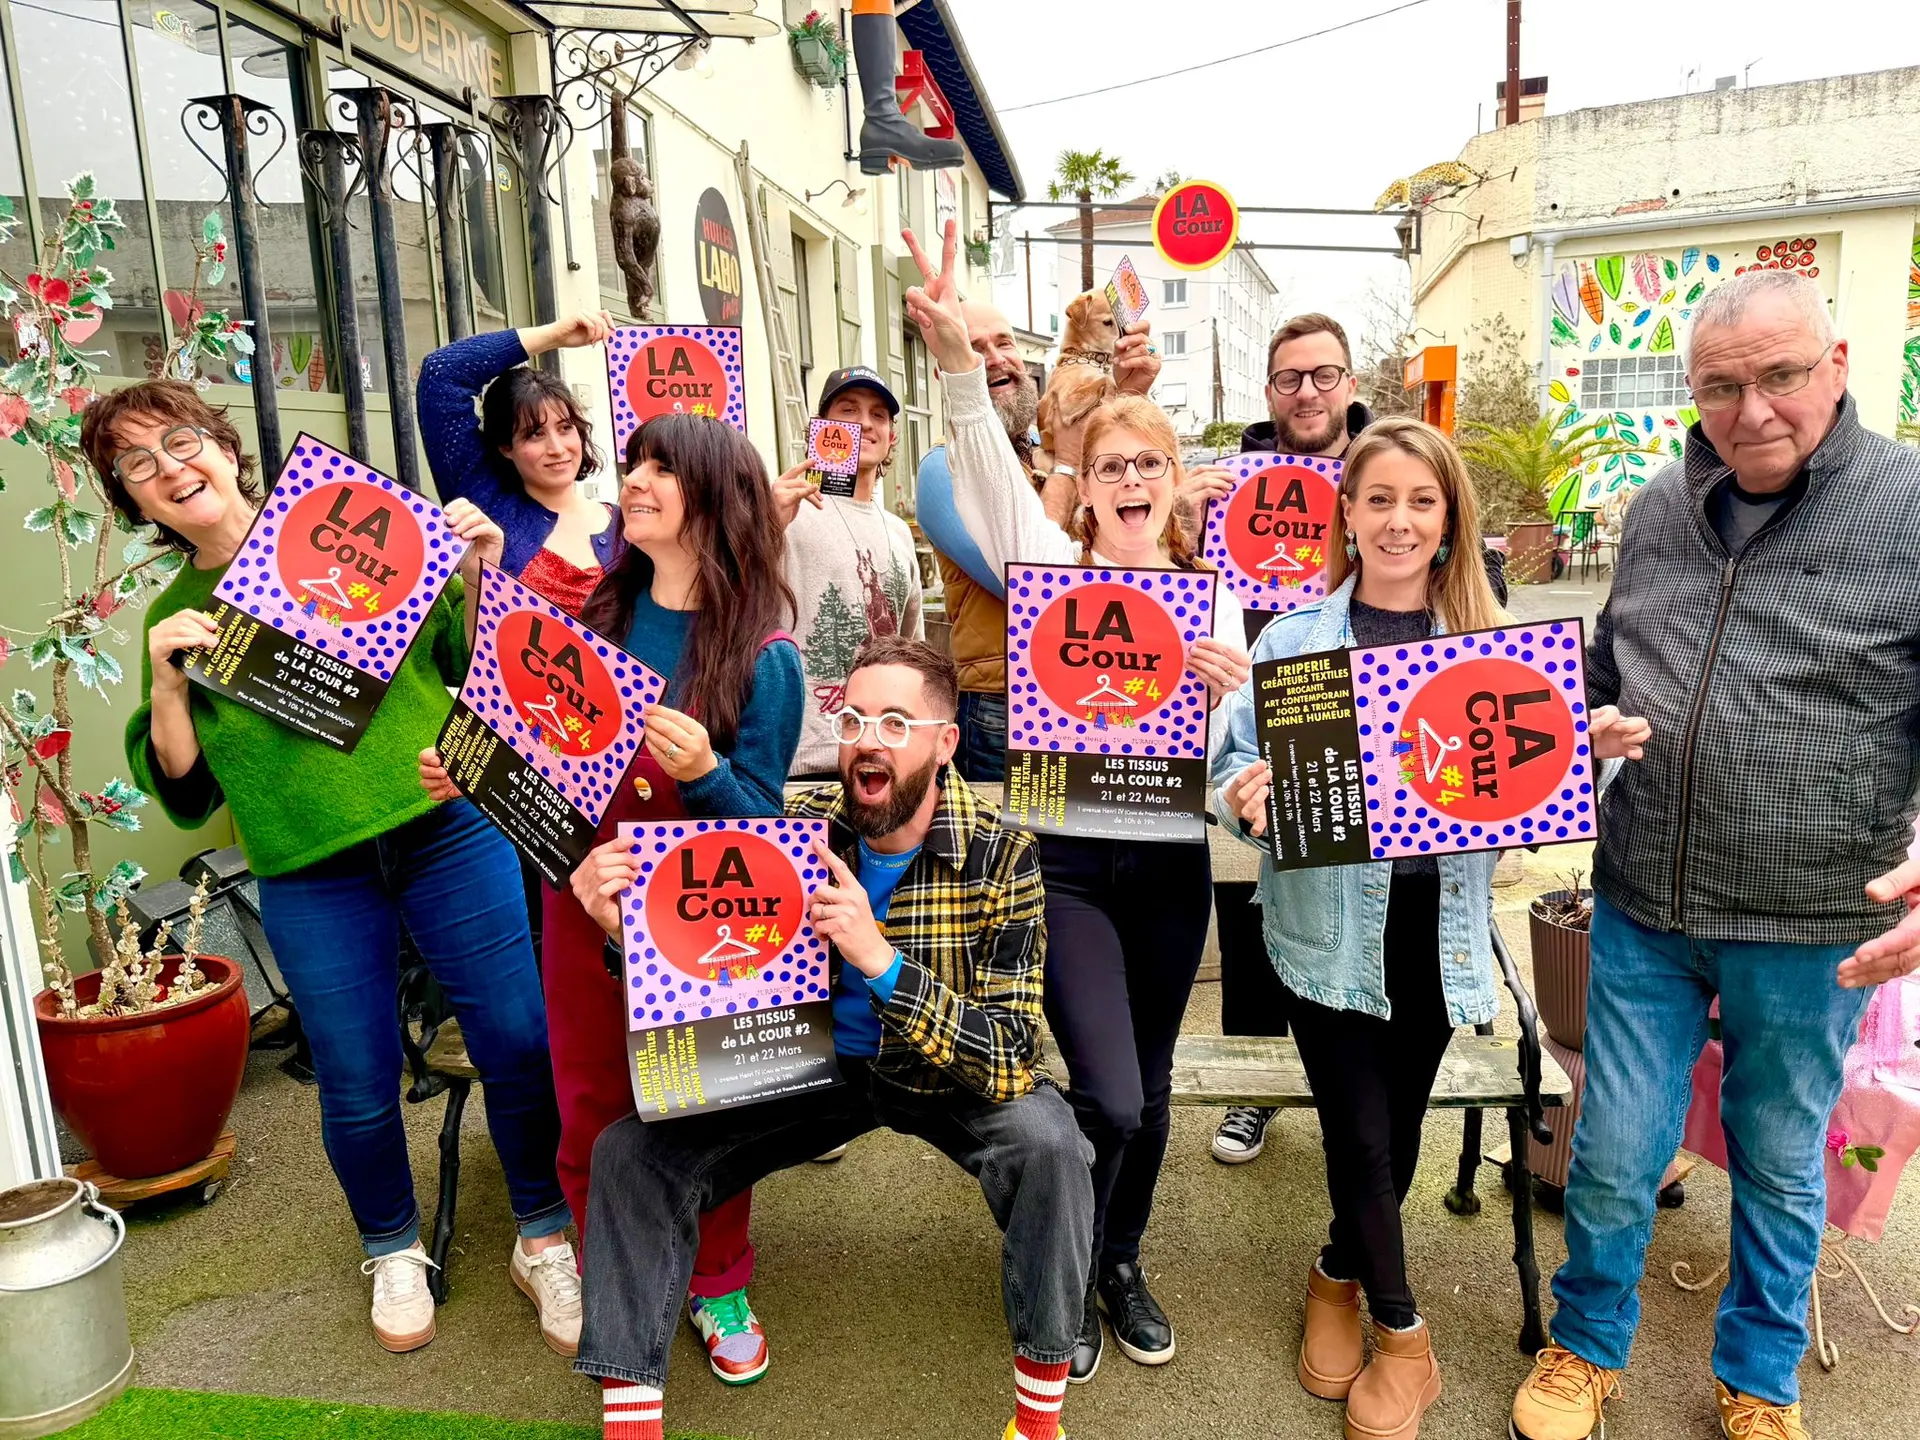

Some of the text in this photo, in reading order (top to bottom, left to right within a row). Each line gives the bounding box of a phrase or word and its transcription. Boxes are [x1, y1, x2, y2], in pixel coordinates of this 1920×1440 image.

[1175, 193, 1210, 218] LA
[702, 216, 734, 251] HUILES
[1172, 218, 1224, 236] Cour
[699, 240, 740, 298] LABO
[646, 347, 695, 376] LA
[646, 378, 713, 398] Cour
[692, 402, 716, 418] #4
[822, 440, 848, 450] Cour
[824, 427, 842, 440] LA
[1254, 476, 1308, 514] LA
[325, 486, 391, 551] LA
[1248, 514, 1327, 540] Cour
[309, 523, 398, 586] Cour
[1294, 544, 1324, 567] #4
[348, 582, 380, 613] #4
[183, 603, 229, 670] CRÉATE TILES
[1064, 597, 1134, 643] LA
[202, 612, 243, 677] ART CONTEMPORAIN
[216, 652, 231, 672] FOOD
[230, 625, 246, 646] TRUCK
[219, 621, 260, 685] BONNE HUMEUR
[292, 643, 354, 679] LES TISSUS
[527, 615, 584, 688] LA
[1058, 642, 1161, 672] Cour
[273, 650, 359, 698] de LA COUR #2
[1261, 668, 1348, 689] CRÉATEURS TEXTILES
[1276, 658, 1330, 677] FRIPERIE
[275, 668, 340, 706] 21 et 22 Mars
[520, 648, 603, 725] Cour
[1124, 677, 1162, 701] #4
[1264, 689, 1349, 708] ART CONTEMPORAIN
[1286, 682, 1324, 695] BROCANTE
[457, 710, 474, 738] TEXTILES
[1266, 708, 1351, 727] BONNE HUMEUR
[1276, 700, 1338, 716] FOOD & TRUCK
[439, 714, 462, 757] FRIPERIE
[456, 733, 472, 761] BROCANTE
[563, 716, 592, 750] #4
[1465, 690, 1499, 798] Cour
[1502, 688, 1556, 769] LA
[455, 723, 486, 782] ART CONTEMPORAIN
[464, 762, 476, 780] FOOD
[475, 737, 488, 757] TRUCK
[467, 736, 499, 793] BONNE HUMEUR
[1105, 758, 1168, 772] LES TISSUS
[522, 766, 570, 814] LES TISSUS
[1009, 766, 1021, 812] FRIPERIE
[1016, 752, 1031, 825] CRÉATEURS TEXTILES
[1030, 774, 1039, 806] BROCANTE
[1039, 754, 1048, 811] CONTEMPORAIN
[1056, 756, 1066, 826] BONNE HUMEUR
[1090, 771, 1182, 788] de LA COUR #2
[1100, 790, 1170, 804] 21 et 22 Mars
[1306, 760, 1323, 832] 21 et 22 Mars
[1324, 747, 1346, 841] de LA COUR #2
[1343, 759, 1362, 826] LES TISSUS
[1437, 766, 1464, 805] #4
[507, 771, 574, 835] de LA COUR #2
[508, 789, 559, 840] 21 et 22 Mars
[680, 846, 754, 890] LA
[676, 892, 781, 922] Cour
[745, 924, 783, 946] #4
[721, 1022, 810, 1049] de LA COUR #2
[733, 1008, 795, 1030] LES TISSUS
[667, 1029, 687, 1108] ART CONTEMPORAIN
[677, 1039, 686, 1064] TRUCK
[685, 1026, 706, 1104] BONNE HUMEUR
[734, 1045, 802, 1065] 21 et 22 Mars
[636, 1048, 653, 1102] FRIPERIE
[646, 1031, 668, 1113] CRÉATEURS TEXTILES
[660, 1054, 672, 1090] BROCANTE
[682, 1074, 693, 1097] FOOD
